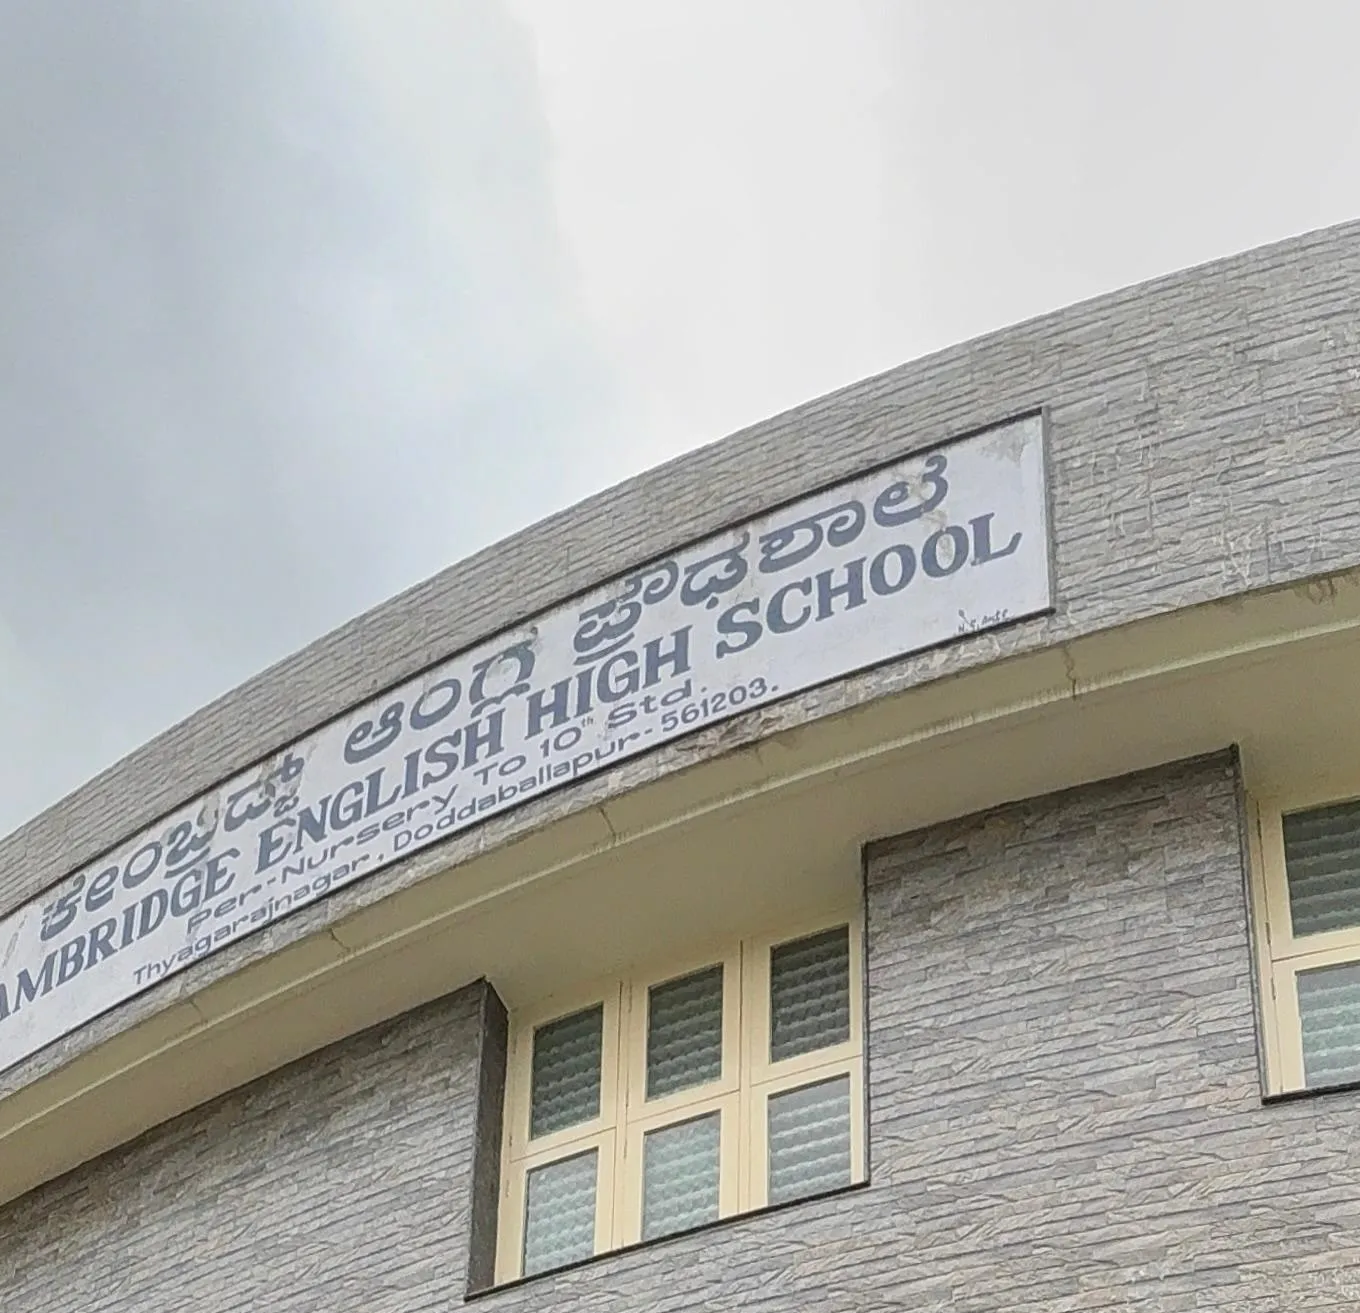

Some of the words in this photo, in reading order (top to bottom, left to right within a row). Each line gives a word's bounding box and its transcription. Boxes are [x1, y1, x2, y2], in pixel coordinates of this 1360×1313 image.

[255, 707, 507, 875] ENGLISH
[524, 624, 693, 741] HIGH
[715, 511, 1023, 659] SCHOOL
